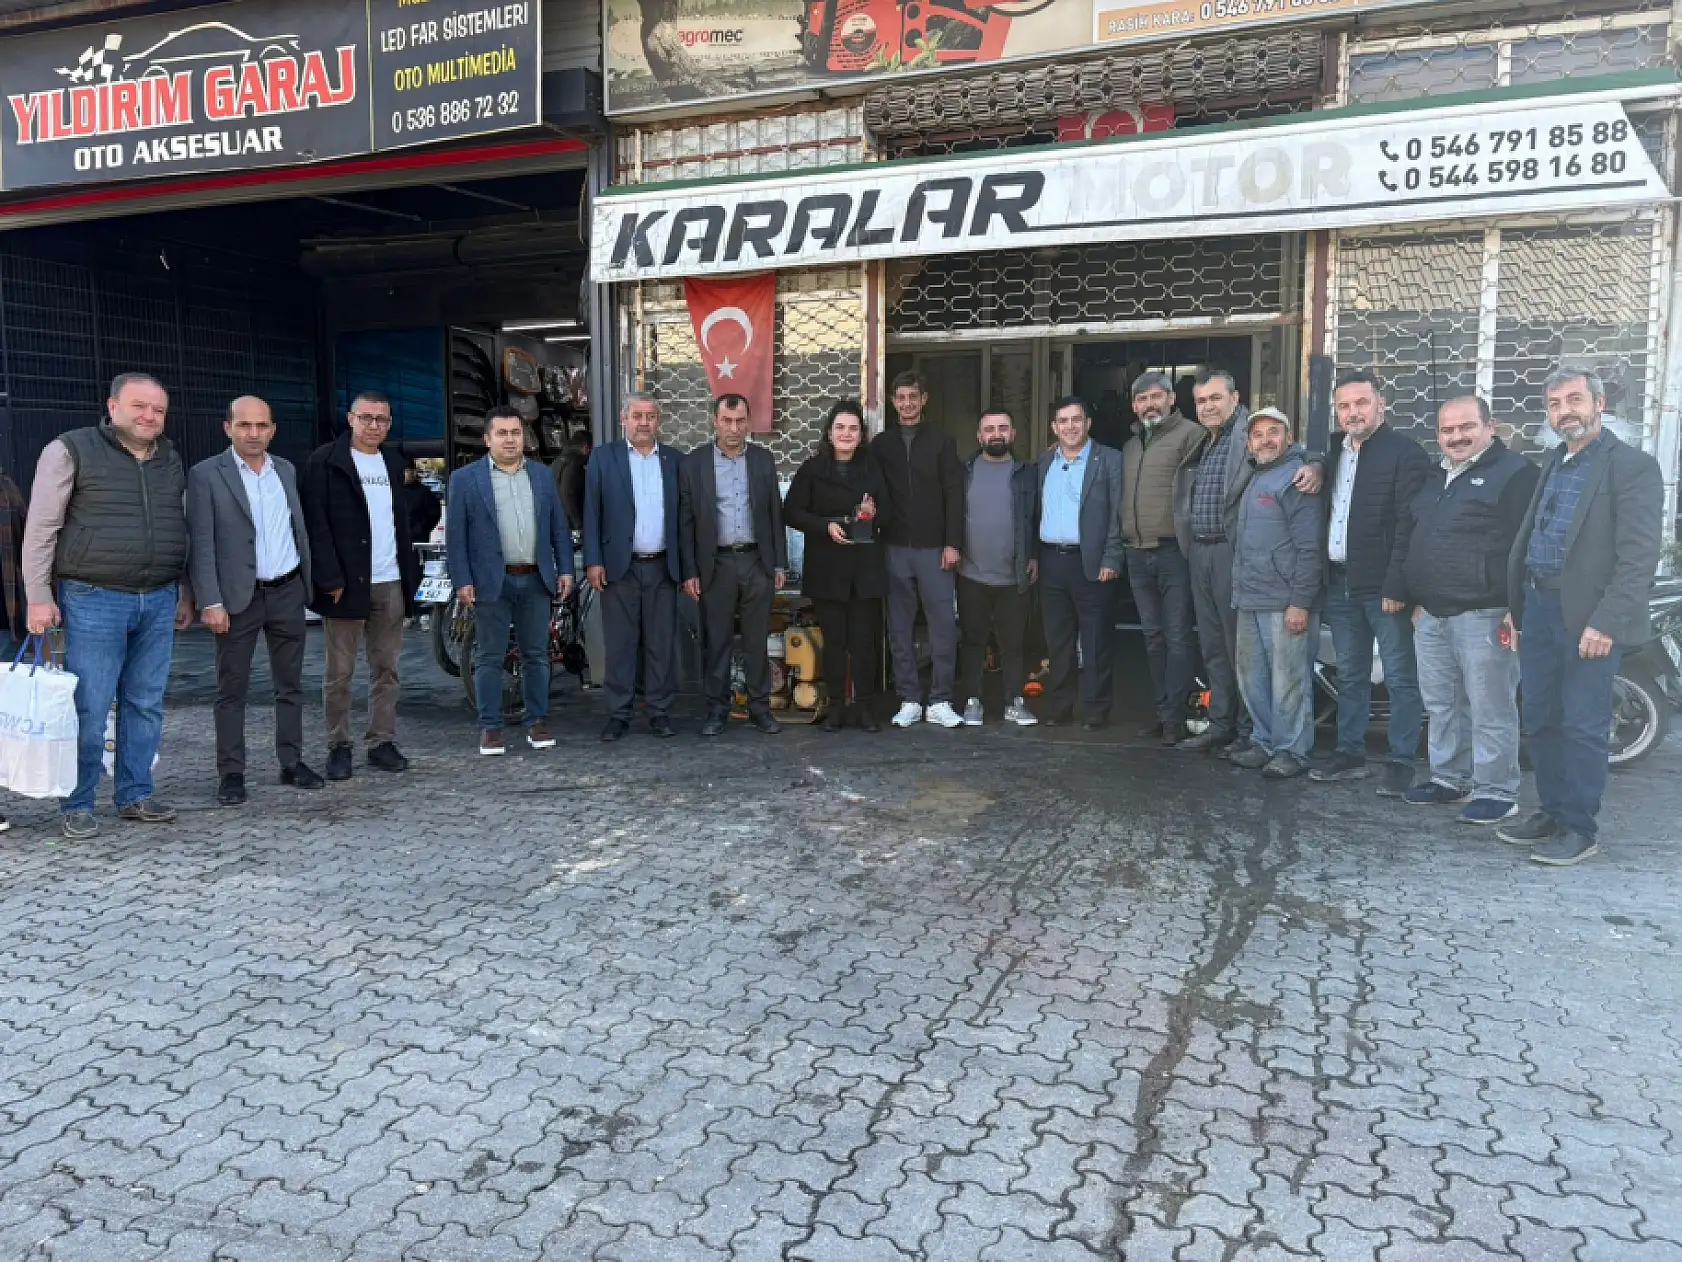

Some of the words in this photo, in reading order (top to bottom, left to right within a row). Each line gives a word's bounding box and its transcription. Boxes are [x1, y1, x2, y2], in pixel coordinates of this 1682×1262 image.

[1200, 2, 1212, 20] 0
[1215, 0, 1249, 18] 546
[380, 27, 406, 53] LED
[411, 20, 438, 47] FAR
[678, 28, 743, 47] agromec
[394, 65, 422, 91] OTO
[427, 43, 516, 86] MULTİMEDİA
[7, 70, 194, 146] YILDIRIM
[204, 44, 358, 121] GARAJ
[392, 111, 402, 133] 0
[406, 105, 436, 130] 536
[440, 98, 471, 125] 886
[475, 95, 493, 118] 72
[498, 90, 520, 115] 32
[74, 143, 124, 171] OTO
[132, 125, 284, 165] AKSESUAR
[1406, 137, 1422, 161] 0
[1430, 132, 1480, 159] 546
[1488, 126, 1538, 154] 791
[1549, 122, 1584, 148] 85
[1593, 118, 1628, 144] 88
[1405, 167, 1421, 190] 0
[1429, 162, 1479, 188] 544
[1487, 157, 1539, 183] 598
[1549, 153, 1582, 178] 16
[1591, 150, 1627, 175] 80
[610, 170, 1046, 268] KARALAR
